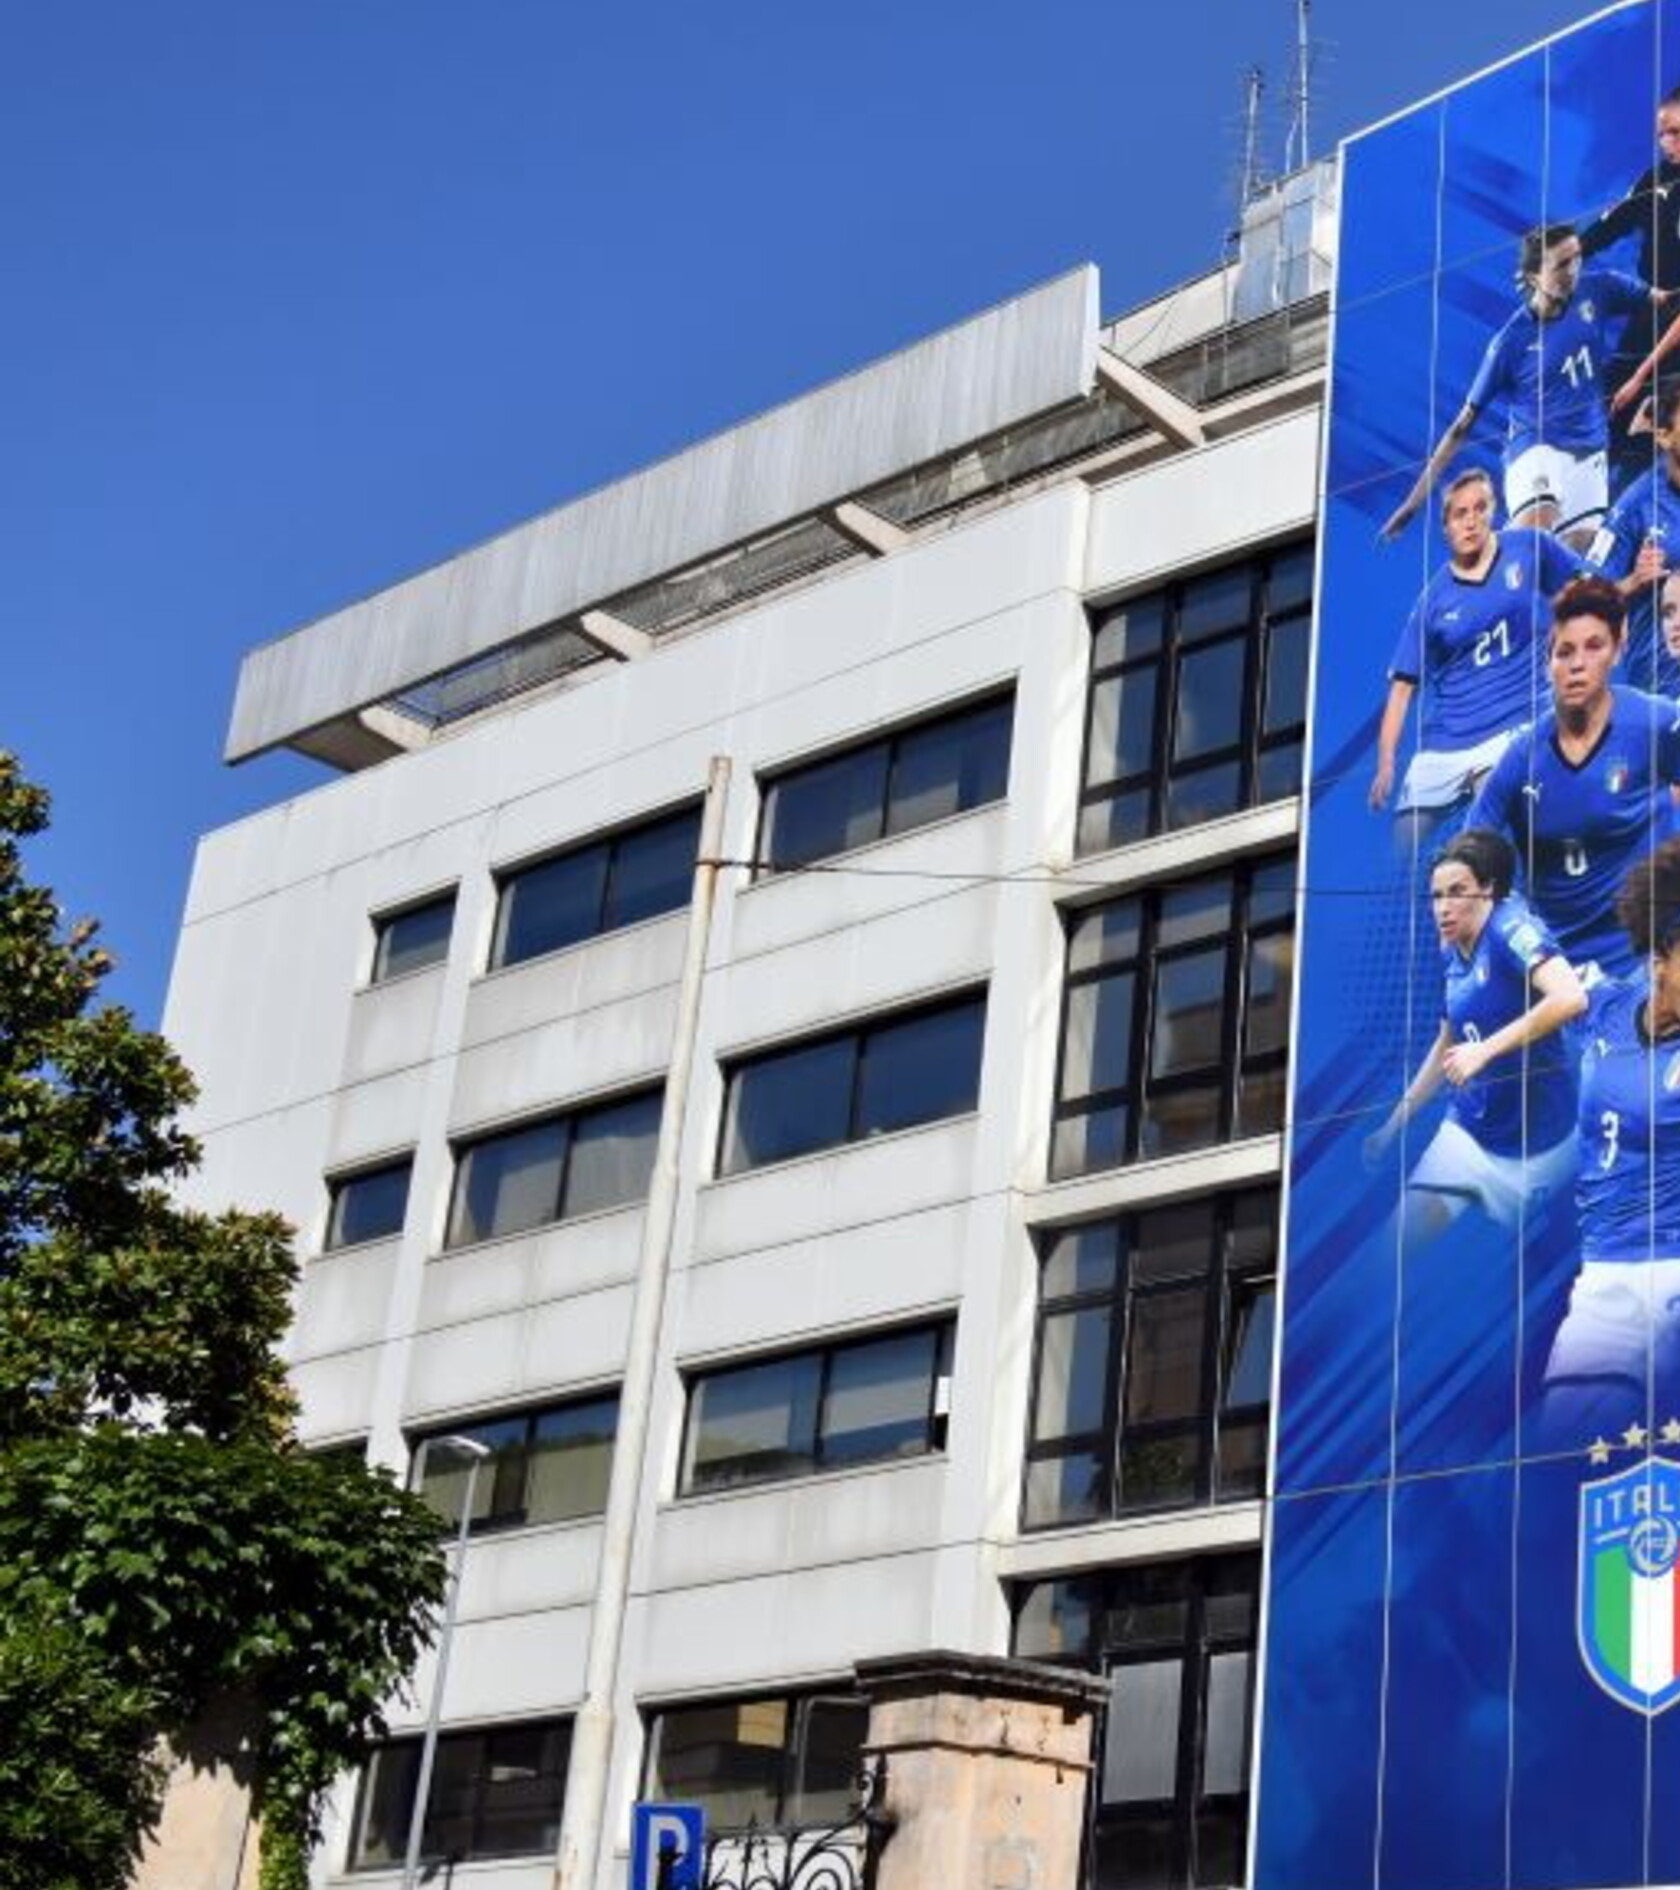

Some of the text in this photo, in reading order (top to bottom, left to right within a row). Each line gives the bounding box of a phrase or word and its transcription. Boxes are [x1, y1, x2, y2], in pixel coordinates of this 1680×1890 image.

[1561, 345, 1594, 388] 11
[1474, 619, 1511, 667] 21
[1600, 1110, 1620, 1171] 3
[645, 1814, 689, 1890] P
